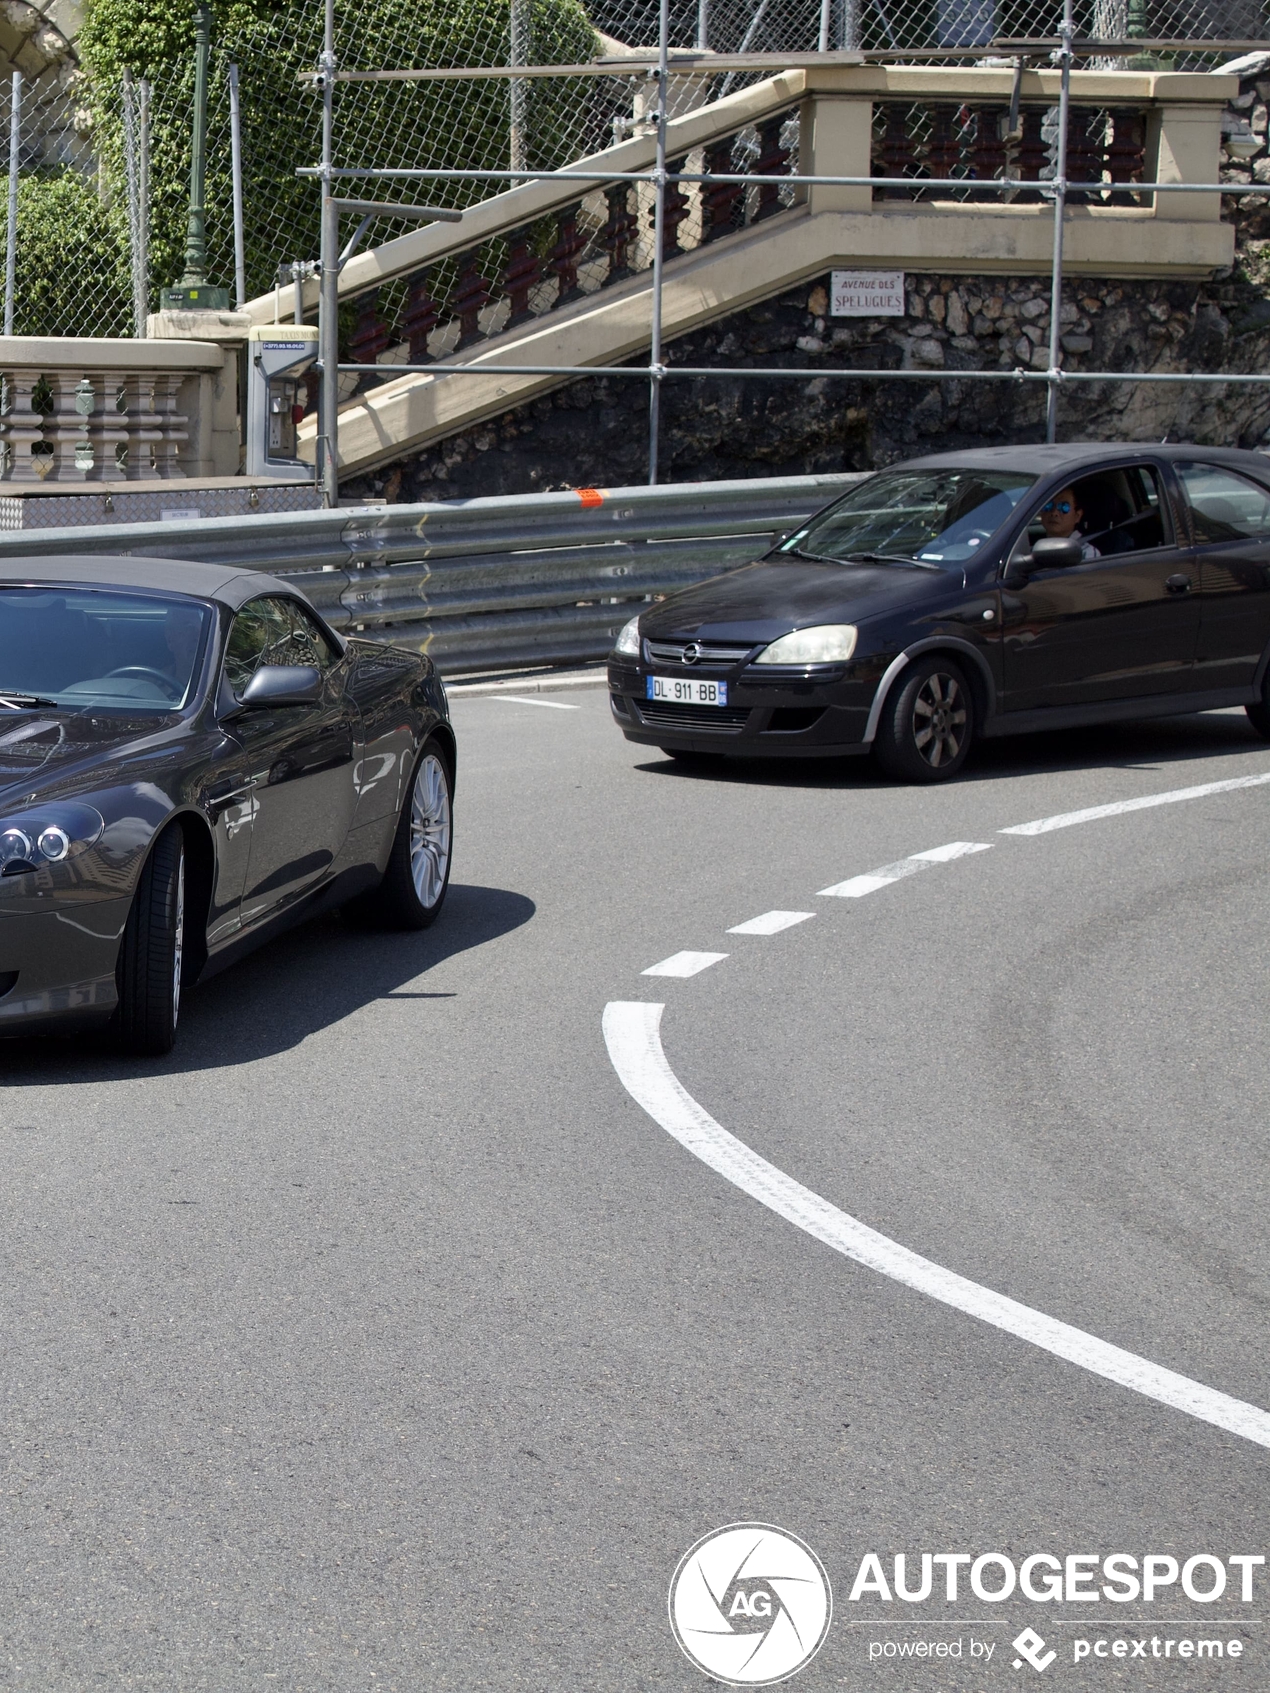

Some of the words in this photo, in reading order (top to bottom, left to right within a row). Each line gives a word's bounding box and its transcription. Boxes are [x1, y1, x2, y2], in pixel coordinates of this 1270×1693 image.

[841, 280, 876, 289] AVENUE
[878, 280, 895, 289] DES
[835, 295, 902, 307] SPELUGUES
[280, 331, 300, 340] TAXIS
